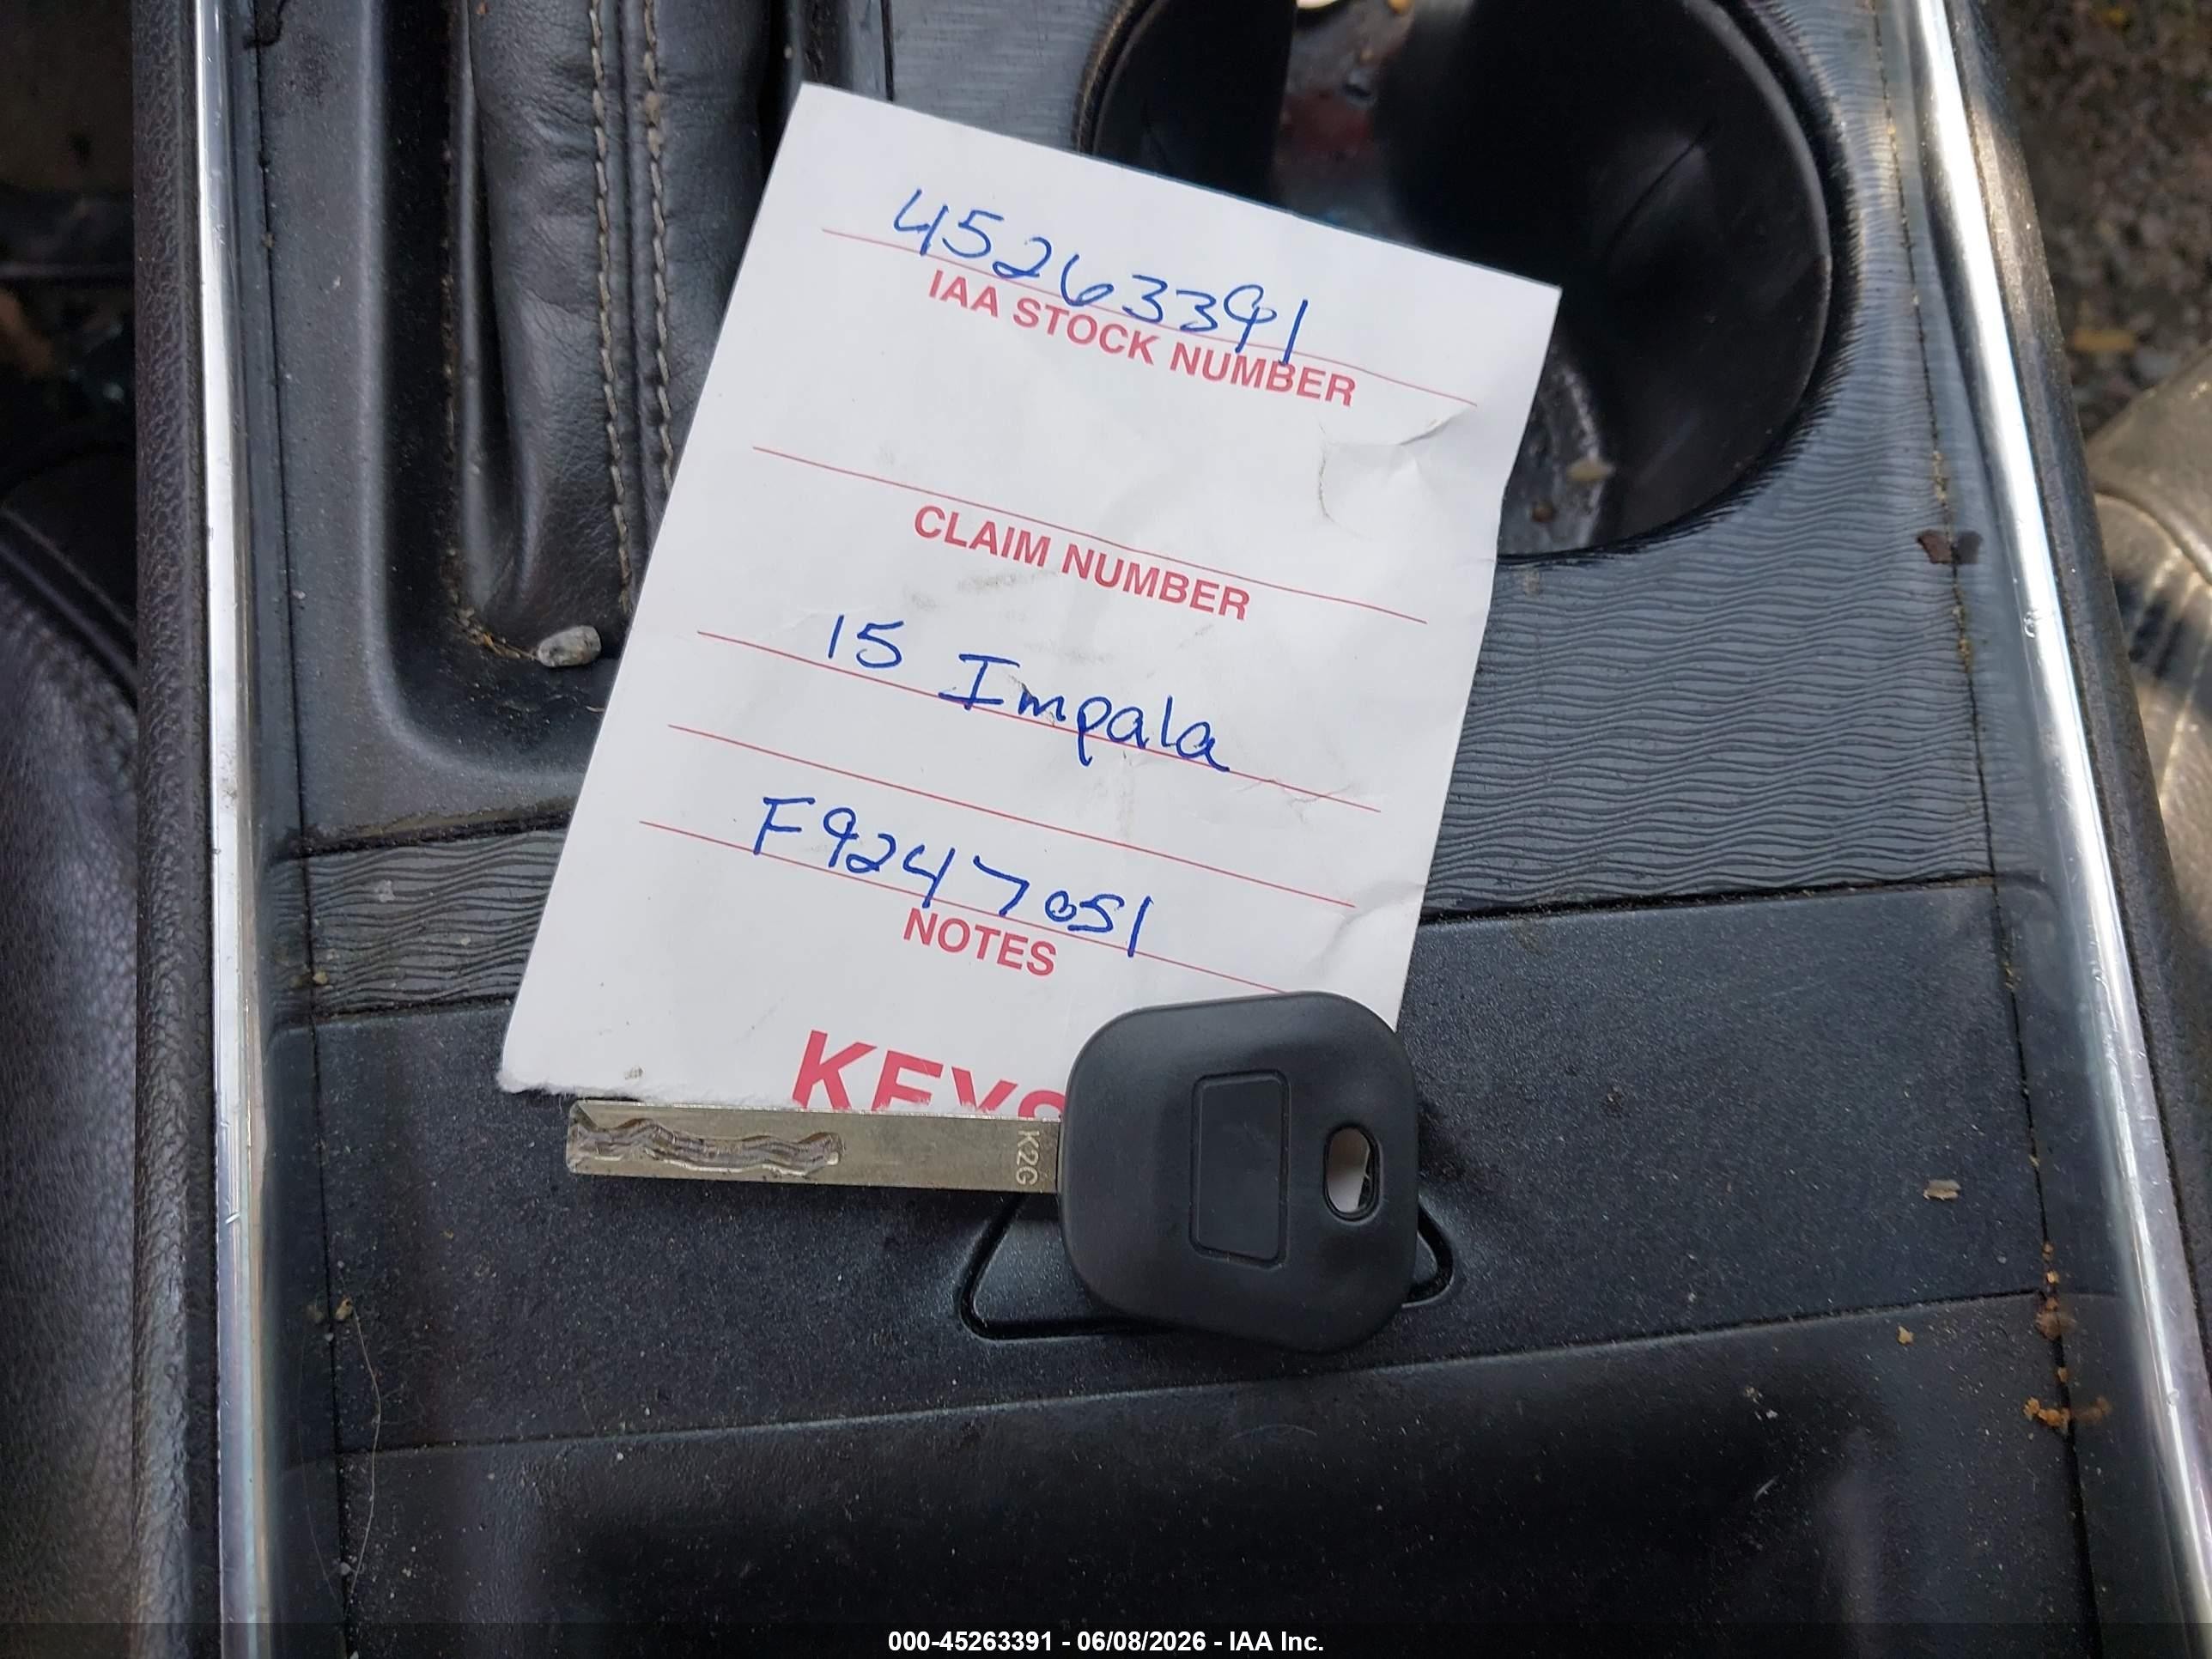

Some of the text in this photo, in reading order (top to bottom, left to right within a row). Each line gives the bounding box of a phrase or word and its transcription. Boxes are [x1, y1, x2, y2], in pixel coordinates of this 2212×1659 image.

[894, 190, 1309, 363] 45263391
[931, 271, 1356, 406] IAA STOCK NUMBER
[915, 505, 1250, 619] CLAIM NUMBER
[829, 616, 1230, 771] 15 Impala
[754, 797, 1153, 957] F9247051
[903, 907, 1057, 977] NOTES
[1016, 1130, 1040, 1185] K2G
